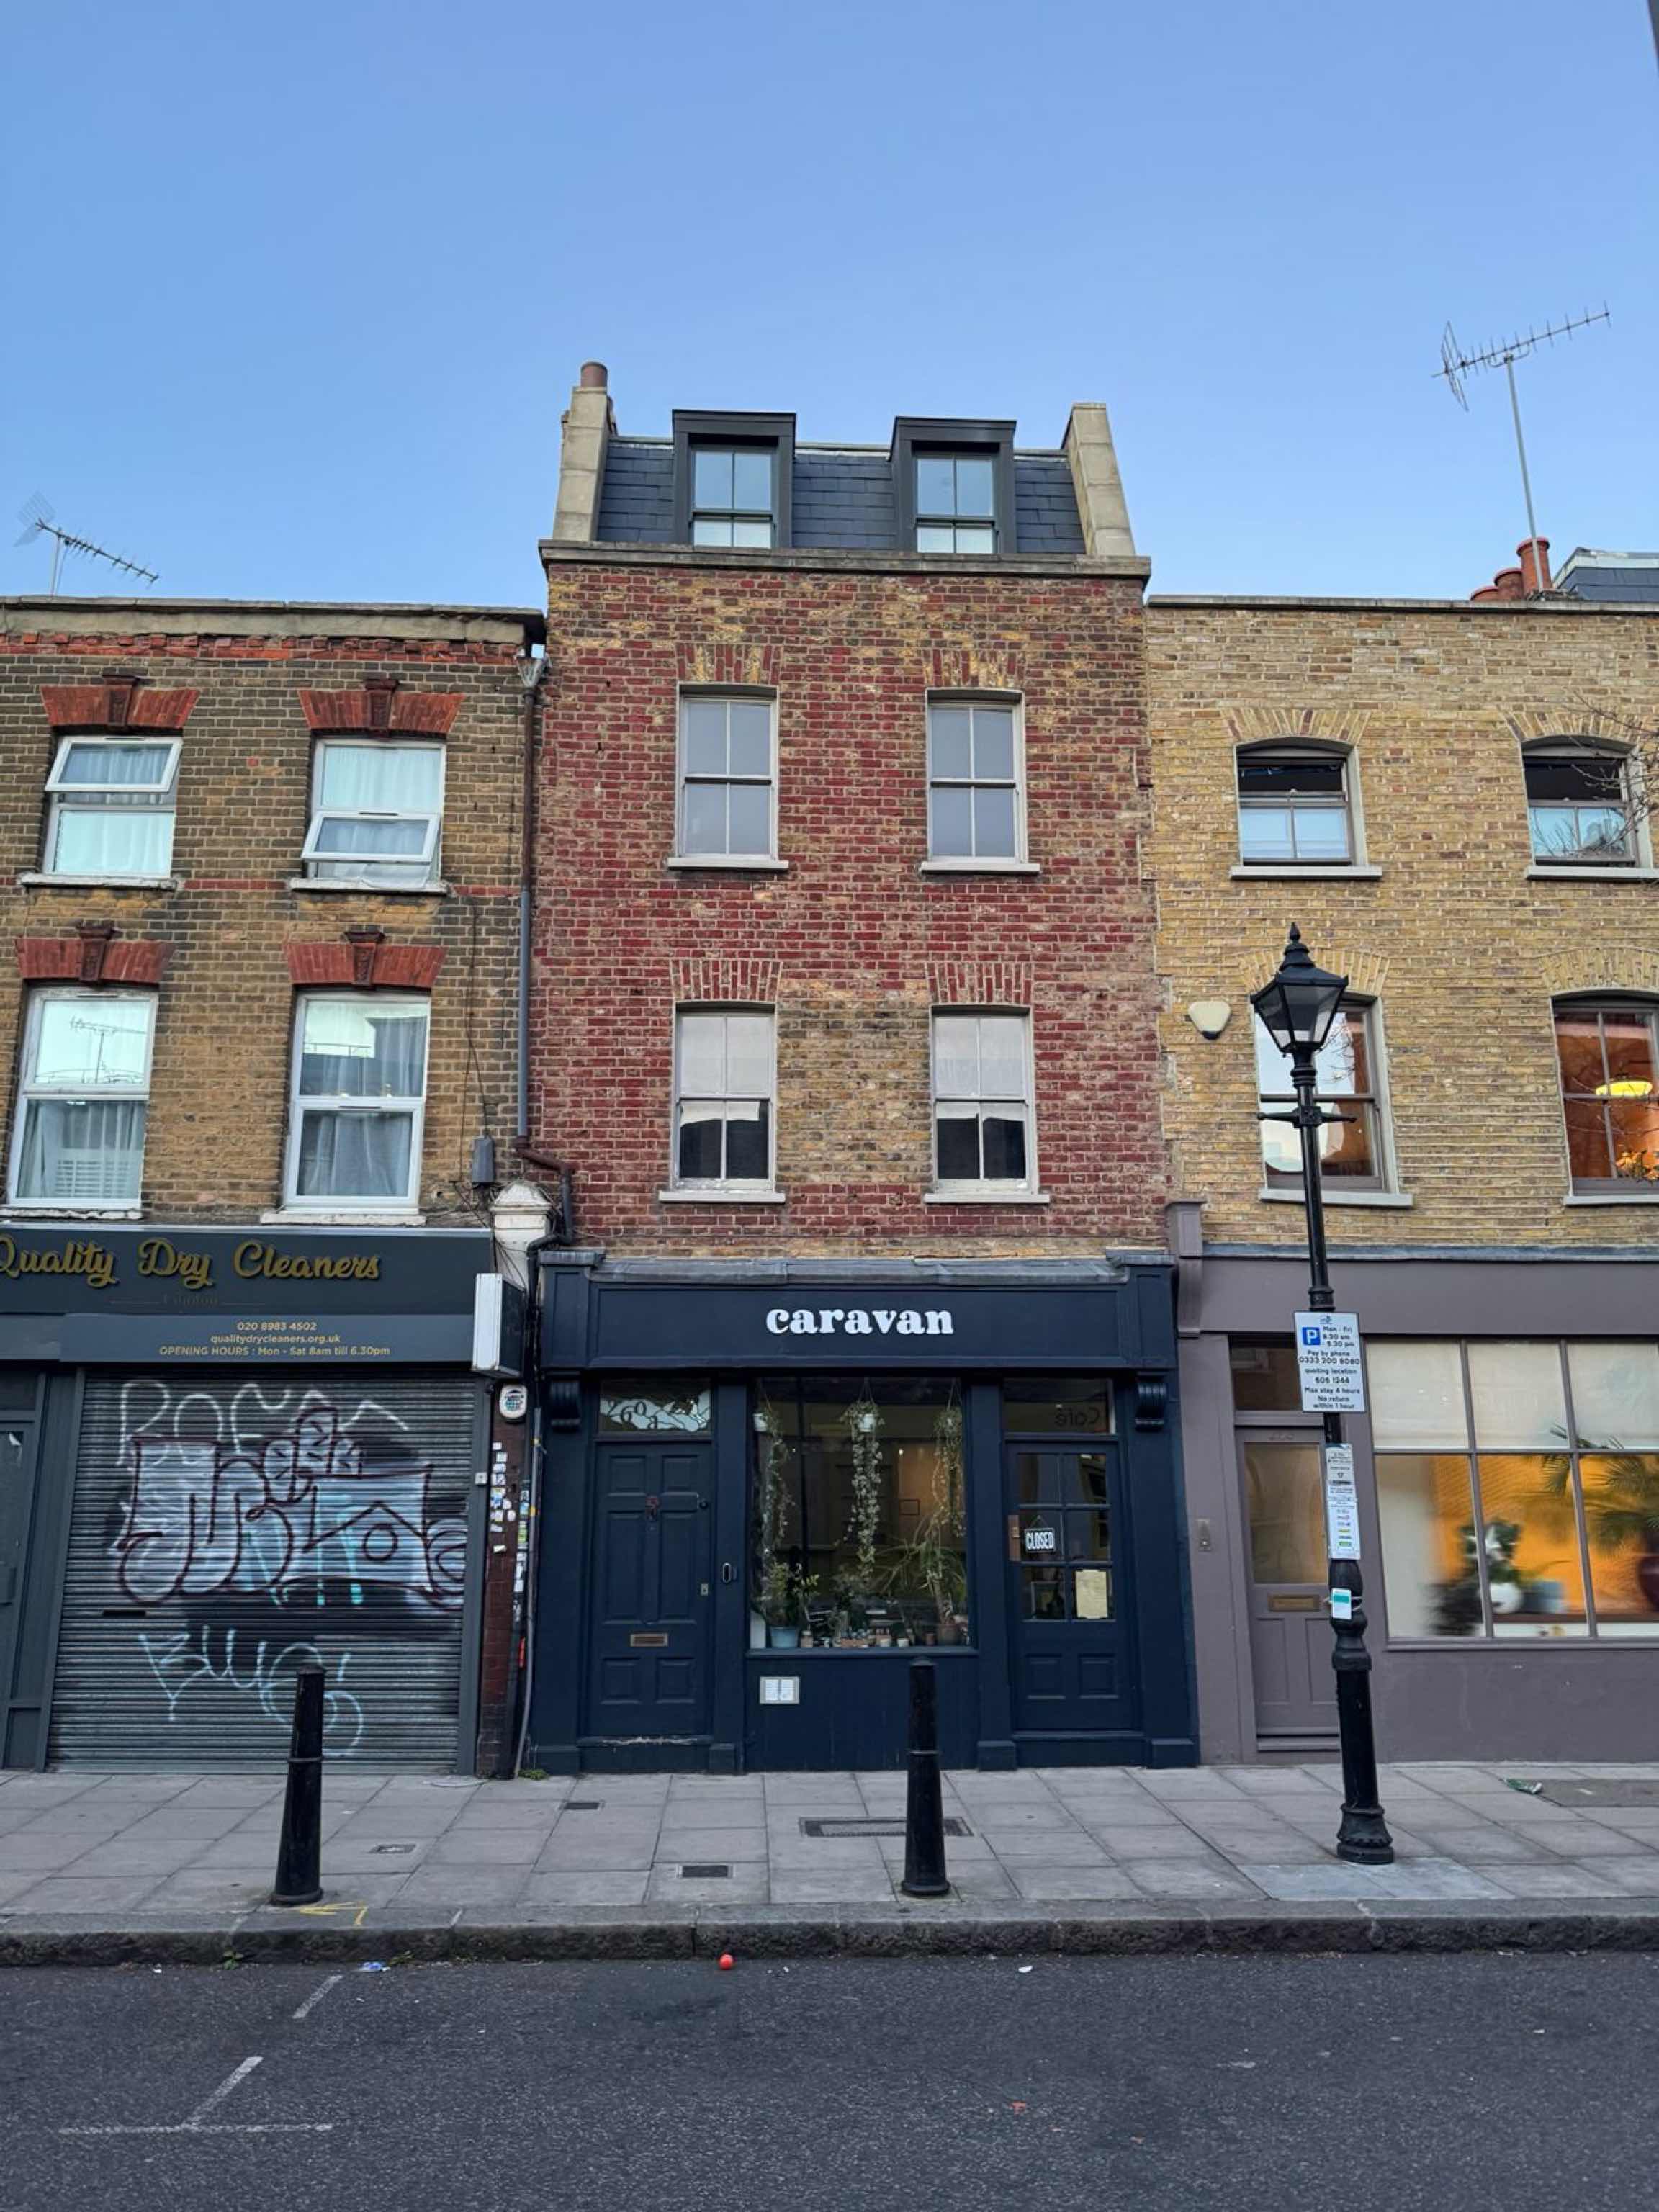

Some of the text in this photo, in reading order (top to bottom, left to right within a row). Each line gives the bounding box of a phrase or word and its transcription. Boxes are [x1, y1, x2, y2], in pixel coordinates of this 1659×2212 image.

[0, 1233, 382, 1290] Quality Dry Cleaners
[237, 1321, 318, 1331] 020 8983 4502
[765, 1309, 954, 1334] caravan
[210, 1334, 341, 1344] qualitydrycleaners.org.uk
[1307, 1329, 1318, 1344] P
[159, 1346, 208, 1355] OPENING
[211, 1346, 249, 1355] HOURS
[258, 1346, 280, 1355] Mon
[289, 1346, 306, 1355] Sat
[334, 1346, 348, 1355] till
[1025, 1531, 1055, 1550] CLOSED
